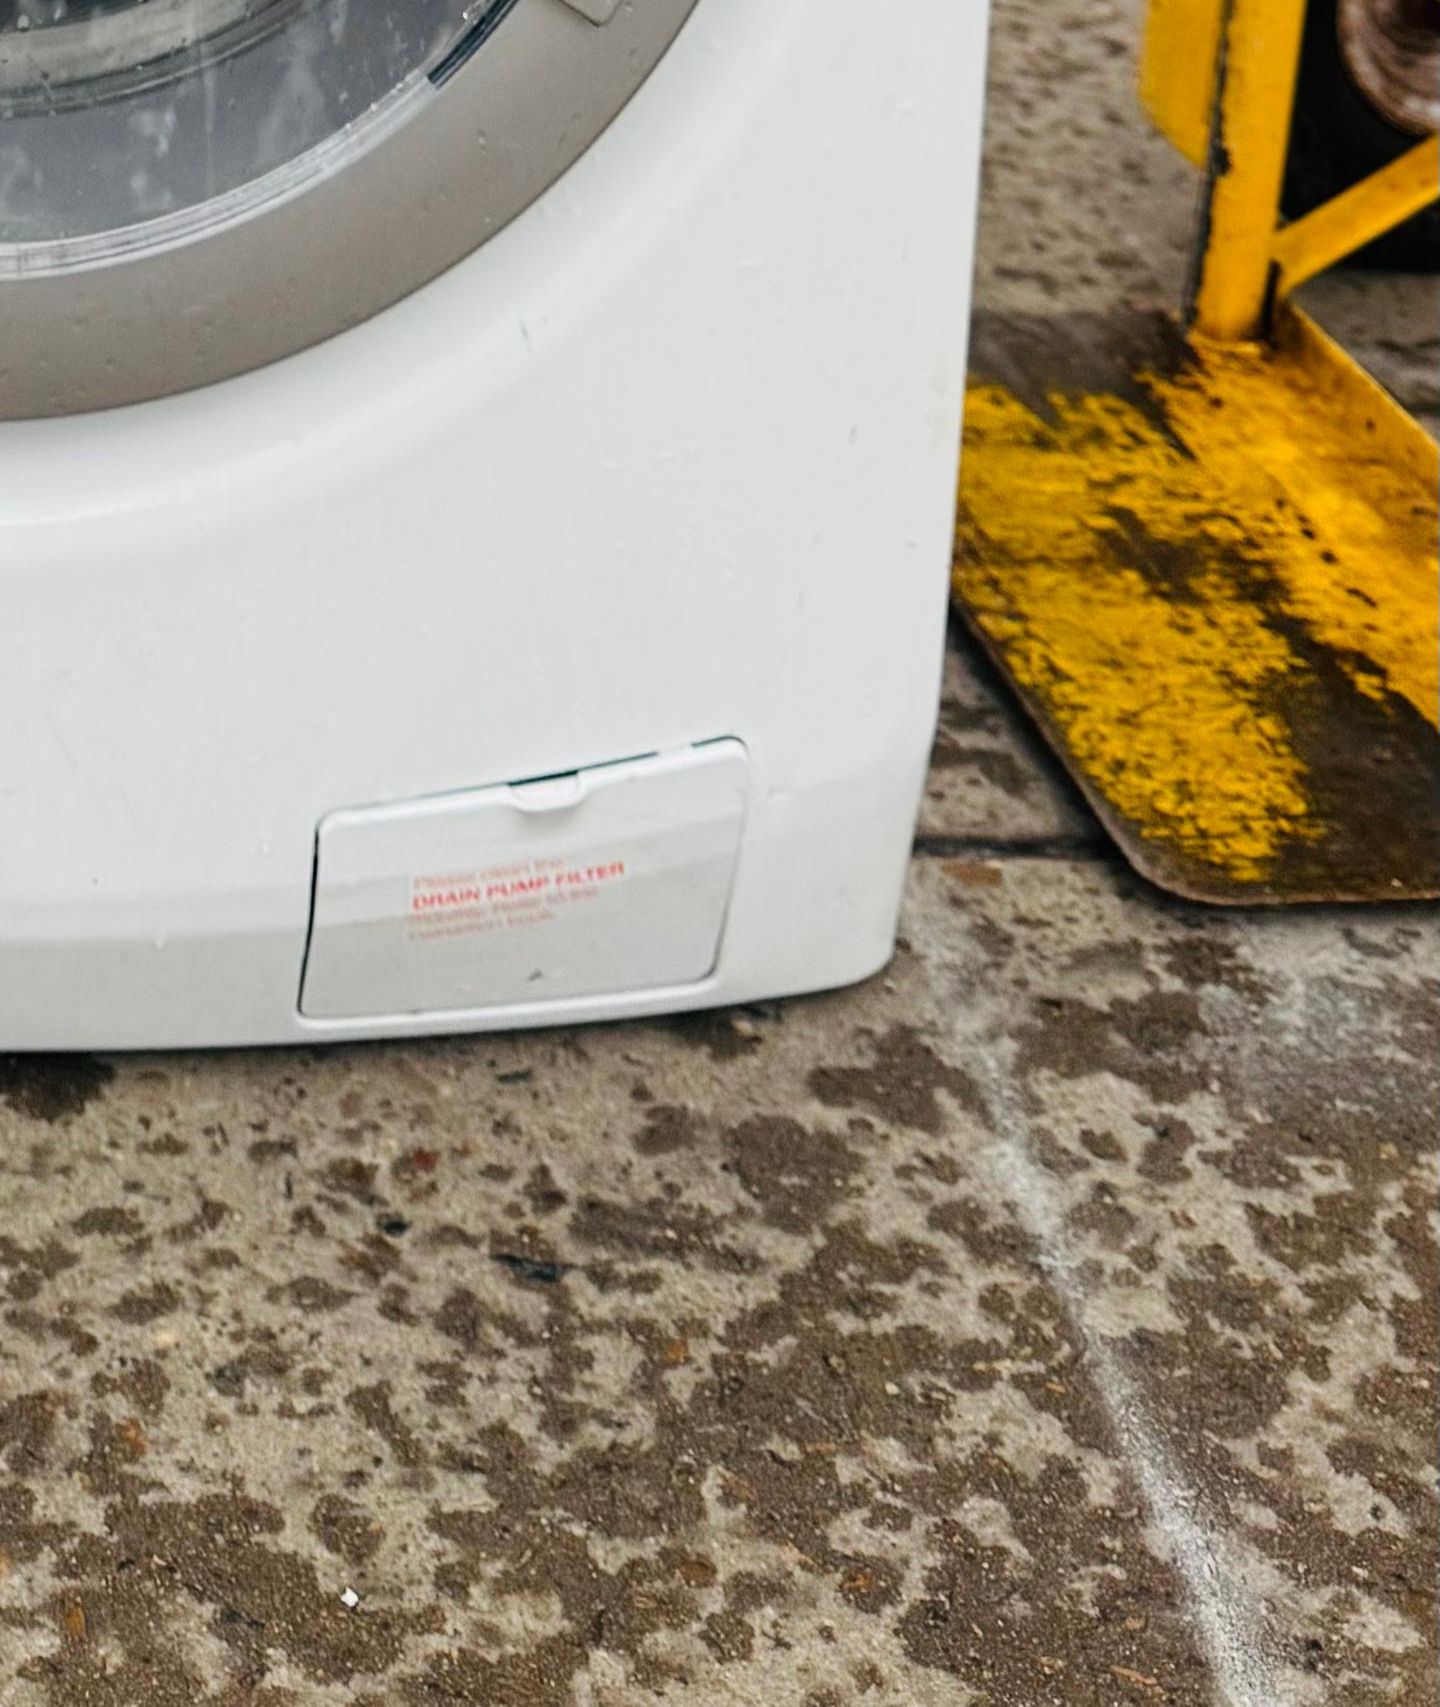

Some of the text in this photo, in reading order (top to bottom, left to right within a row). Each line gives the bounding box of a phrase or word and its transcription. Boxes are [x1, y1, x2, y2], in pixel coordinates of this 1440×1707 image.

[413, 887, 481, 910] DRAIN
[486, 875, 549, 898] PUMP
[555, 862, 625, 886] FILTER
